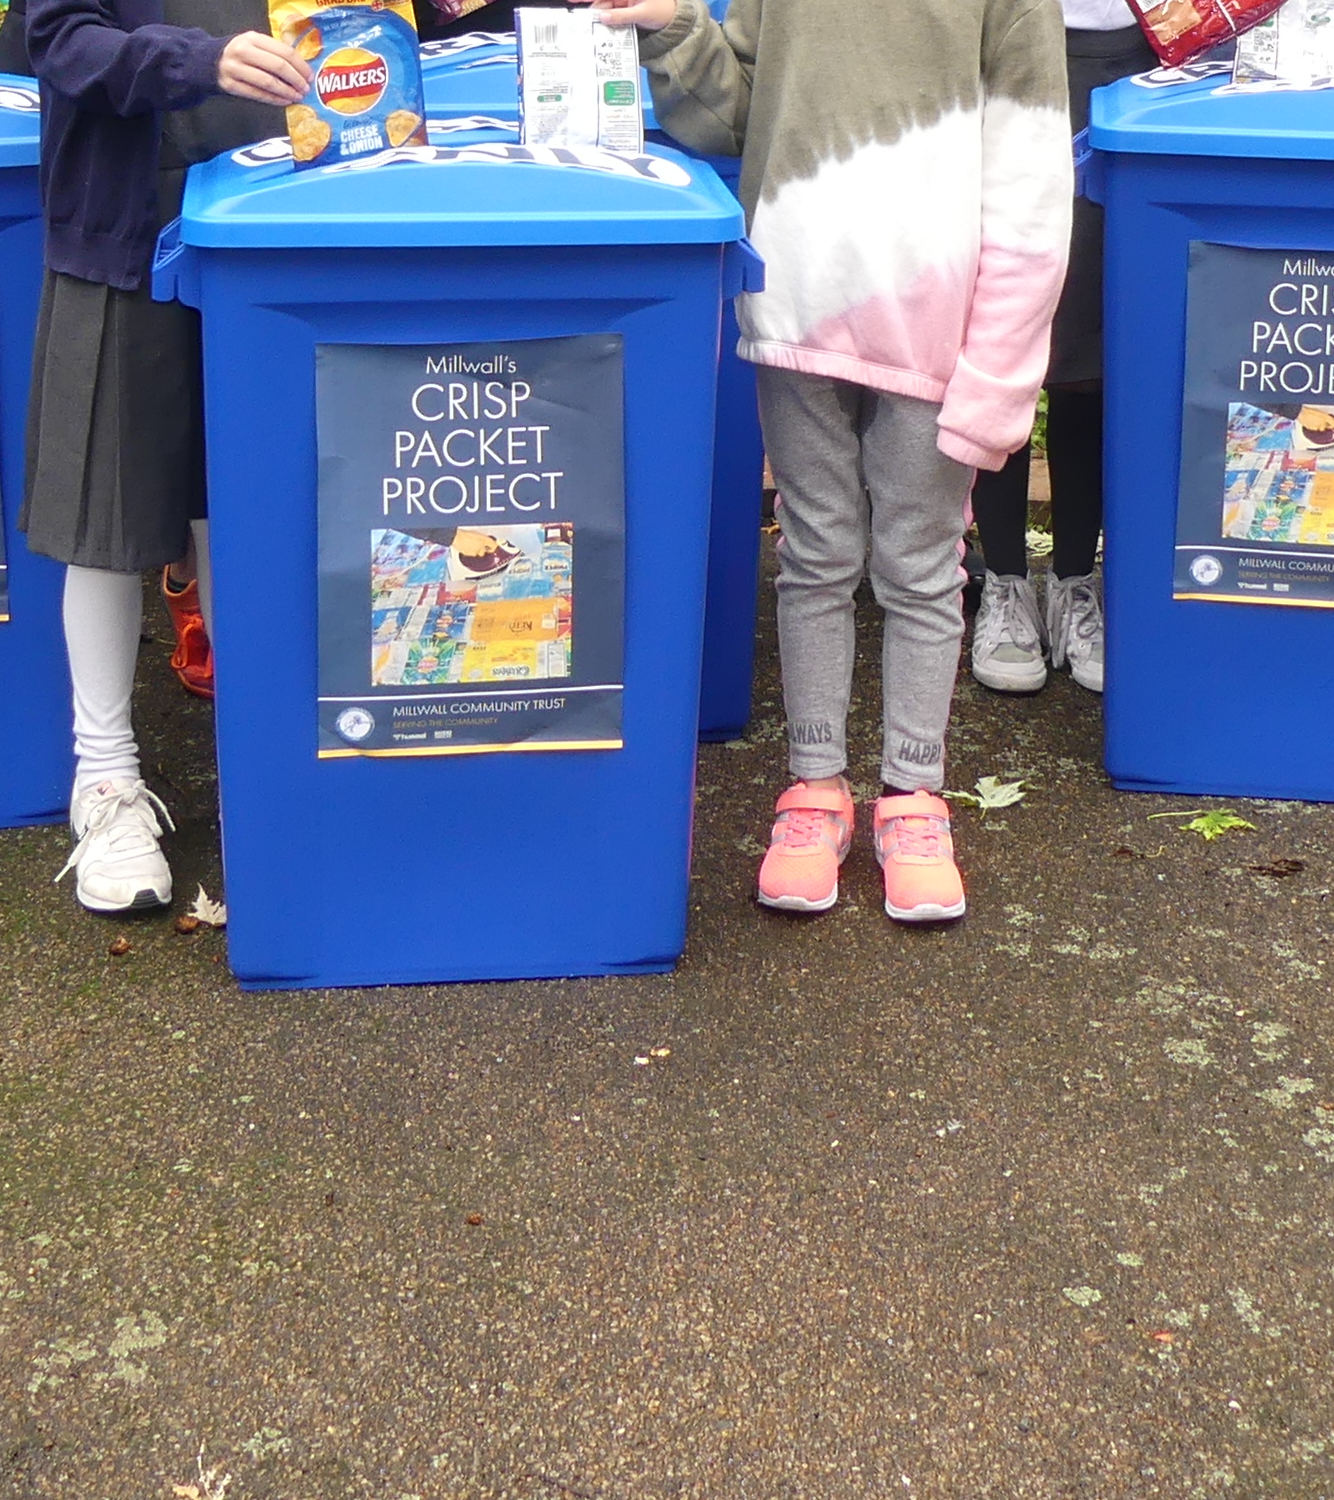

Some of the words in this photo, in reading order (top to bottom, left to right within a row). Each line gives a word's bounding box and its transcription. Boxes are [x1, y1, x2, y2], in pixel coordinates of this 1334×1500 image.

[318, 67, 385, 94] WALKERS
[340, 124, 379, 142] CHEESE
[426, 355, 518, 376] Millwall's
[411, 382, 532, 421] CRISP
[394, 425, 550, 468] PACKET
[382, 471, 564, 516] PROJECT
[1238, 558, 1285, 570] MILLWALL
[393, 706, 447, 717] MILLWALL
[450, 701, 530, 715] COMMUNITY
[533, 698, 566, 710] TRUST
